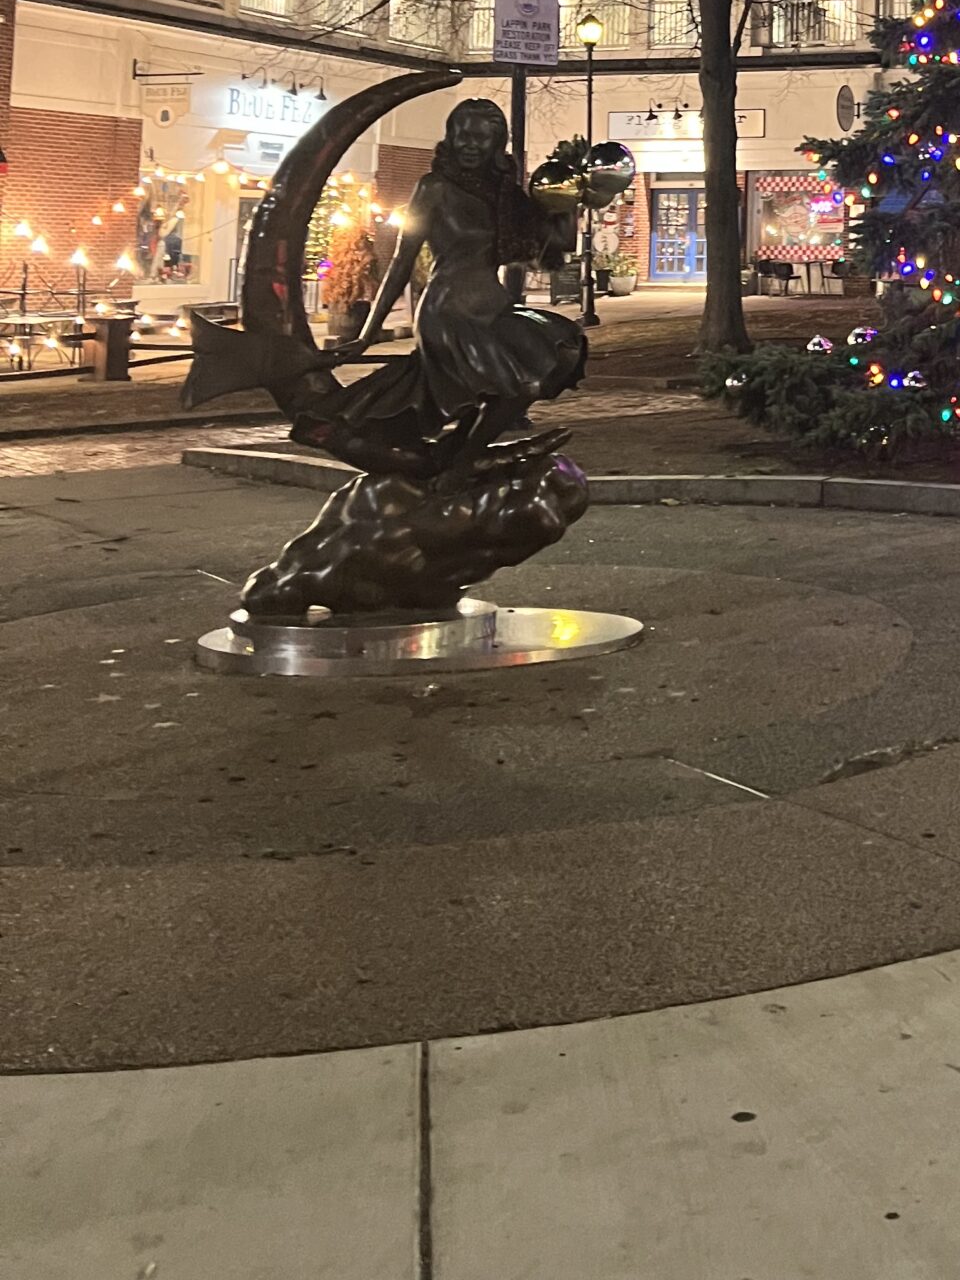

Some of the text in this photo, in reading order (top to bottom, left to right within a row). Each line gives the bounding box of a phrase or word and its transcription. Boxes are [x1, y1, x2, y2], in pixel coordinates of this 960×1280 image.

[501, 19, 551, 32] LAPPIN PARK
[501, 29, 551, 41] RESTORATION
[496, 40, 522, 50] PLEASE
[524, 42, 541, 51] KEEP
[496, 50, 518, 60] GRASS
[520, 51, 541, 61] THANK
[226, 87, 314, 124] BLUE FEZ
